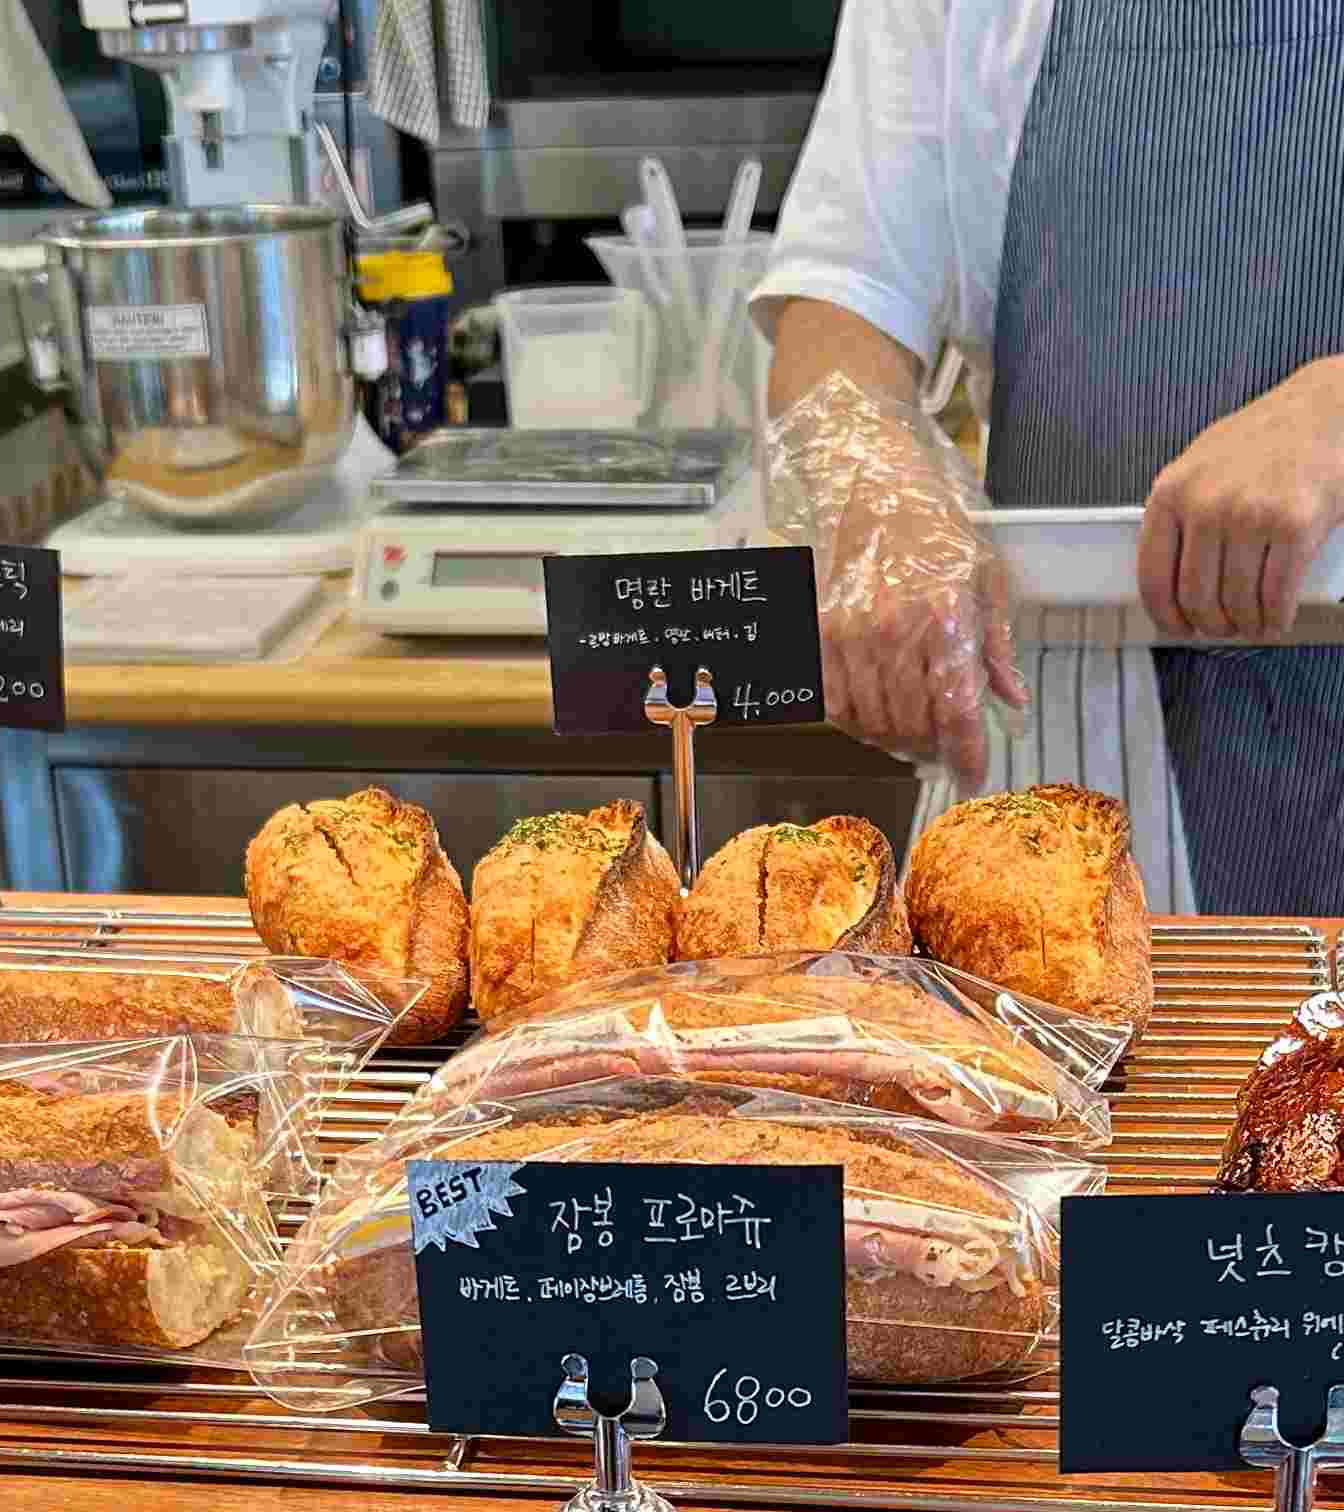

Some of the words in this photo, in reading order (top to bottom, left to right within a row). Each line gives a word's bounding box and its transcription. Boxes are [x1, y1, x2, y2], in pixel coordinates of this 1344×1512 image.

[615, 576, 672, 610] 명란
[691, 570, 768, 602] 바게트
[415, 1166, 485, 1219] BEST
[549, 1186, 614, 1255] 잠봉
[642, 1192, 772, 1249] 프로마쥬
[1207, 1223, 1292, 1283] 넛츠
[1101, 1317, 1187, 1350] 달콤바삭
[1302, 1311, 1344, 1336] 위에
[703, 1367, 812, 1425] 6800
